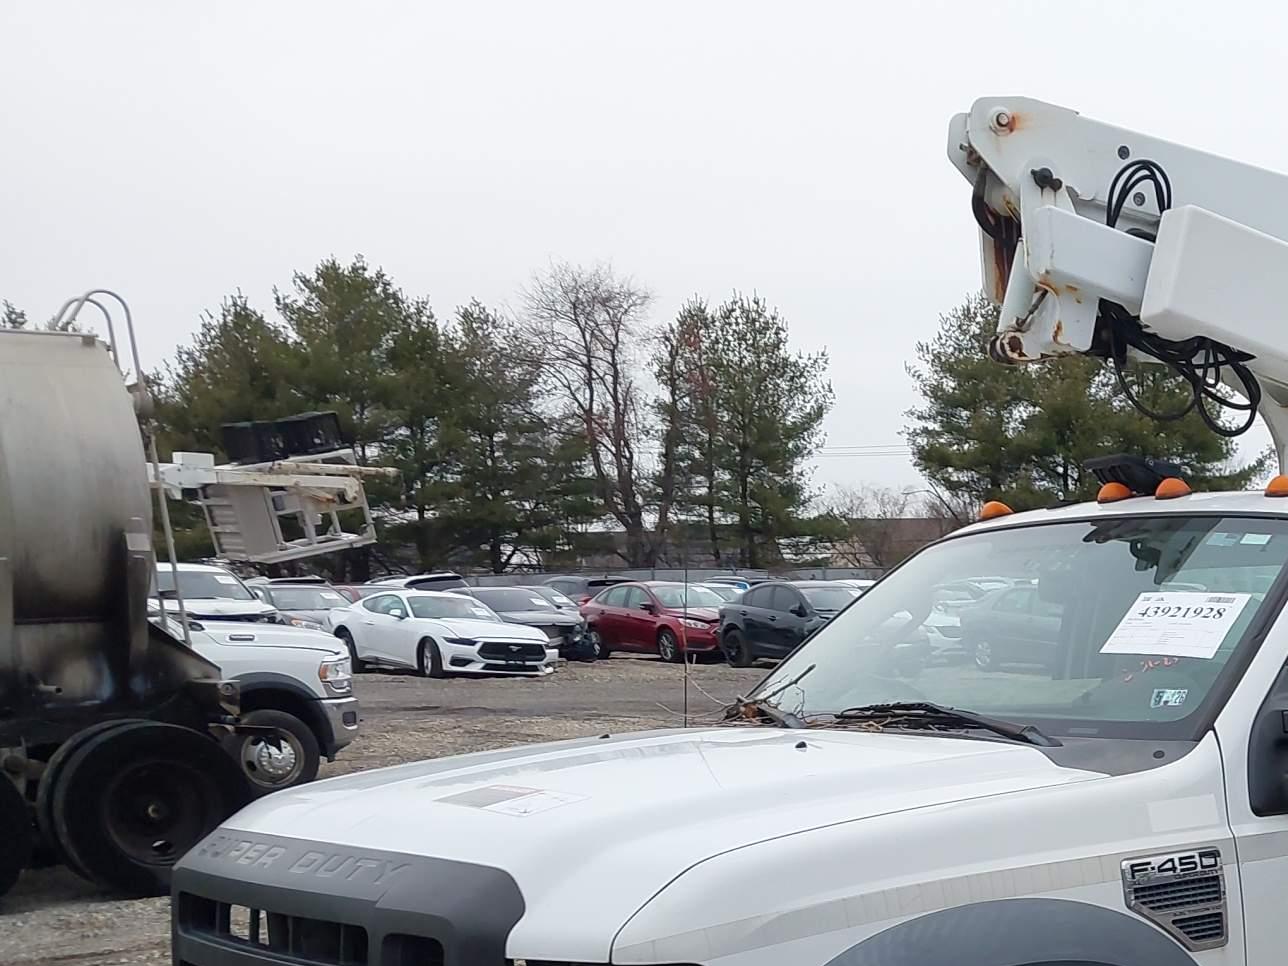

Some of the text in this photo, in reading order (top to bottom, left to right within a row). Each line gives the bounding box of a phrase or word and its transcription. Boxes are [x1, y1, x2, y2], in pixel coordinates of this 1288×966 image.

[1137, 606, 1227, 619] 43921928
[287, 850, 413, 885] DUTY
[1129, 849, 1220, 879] F-450
